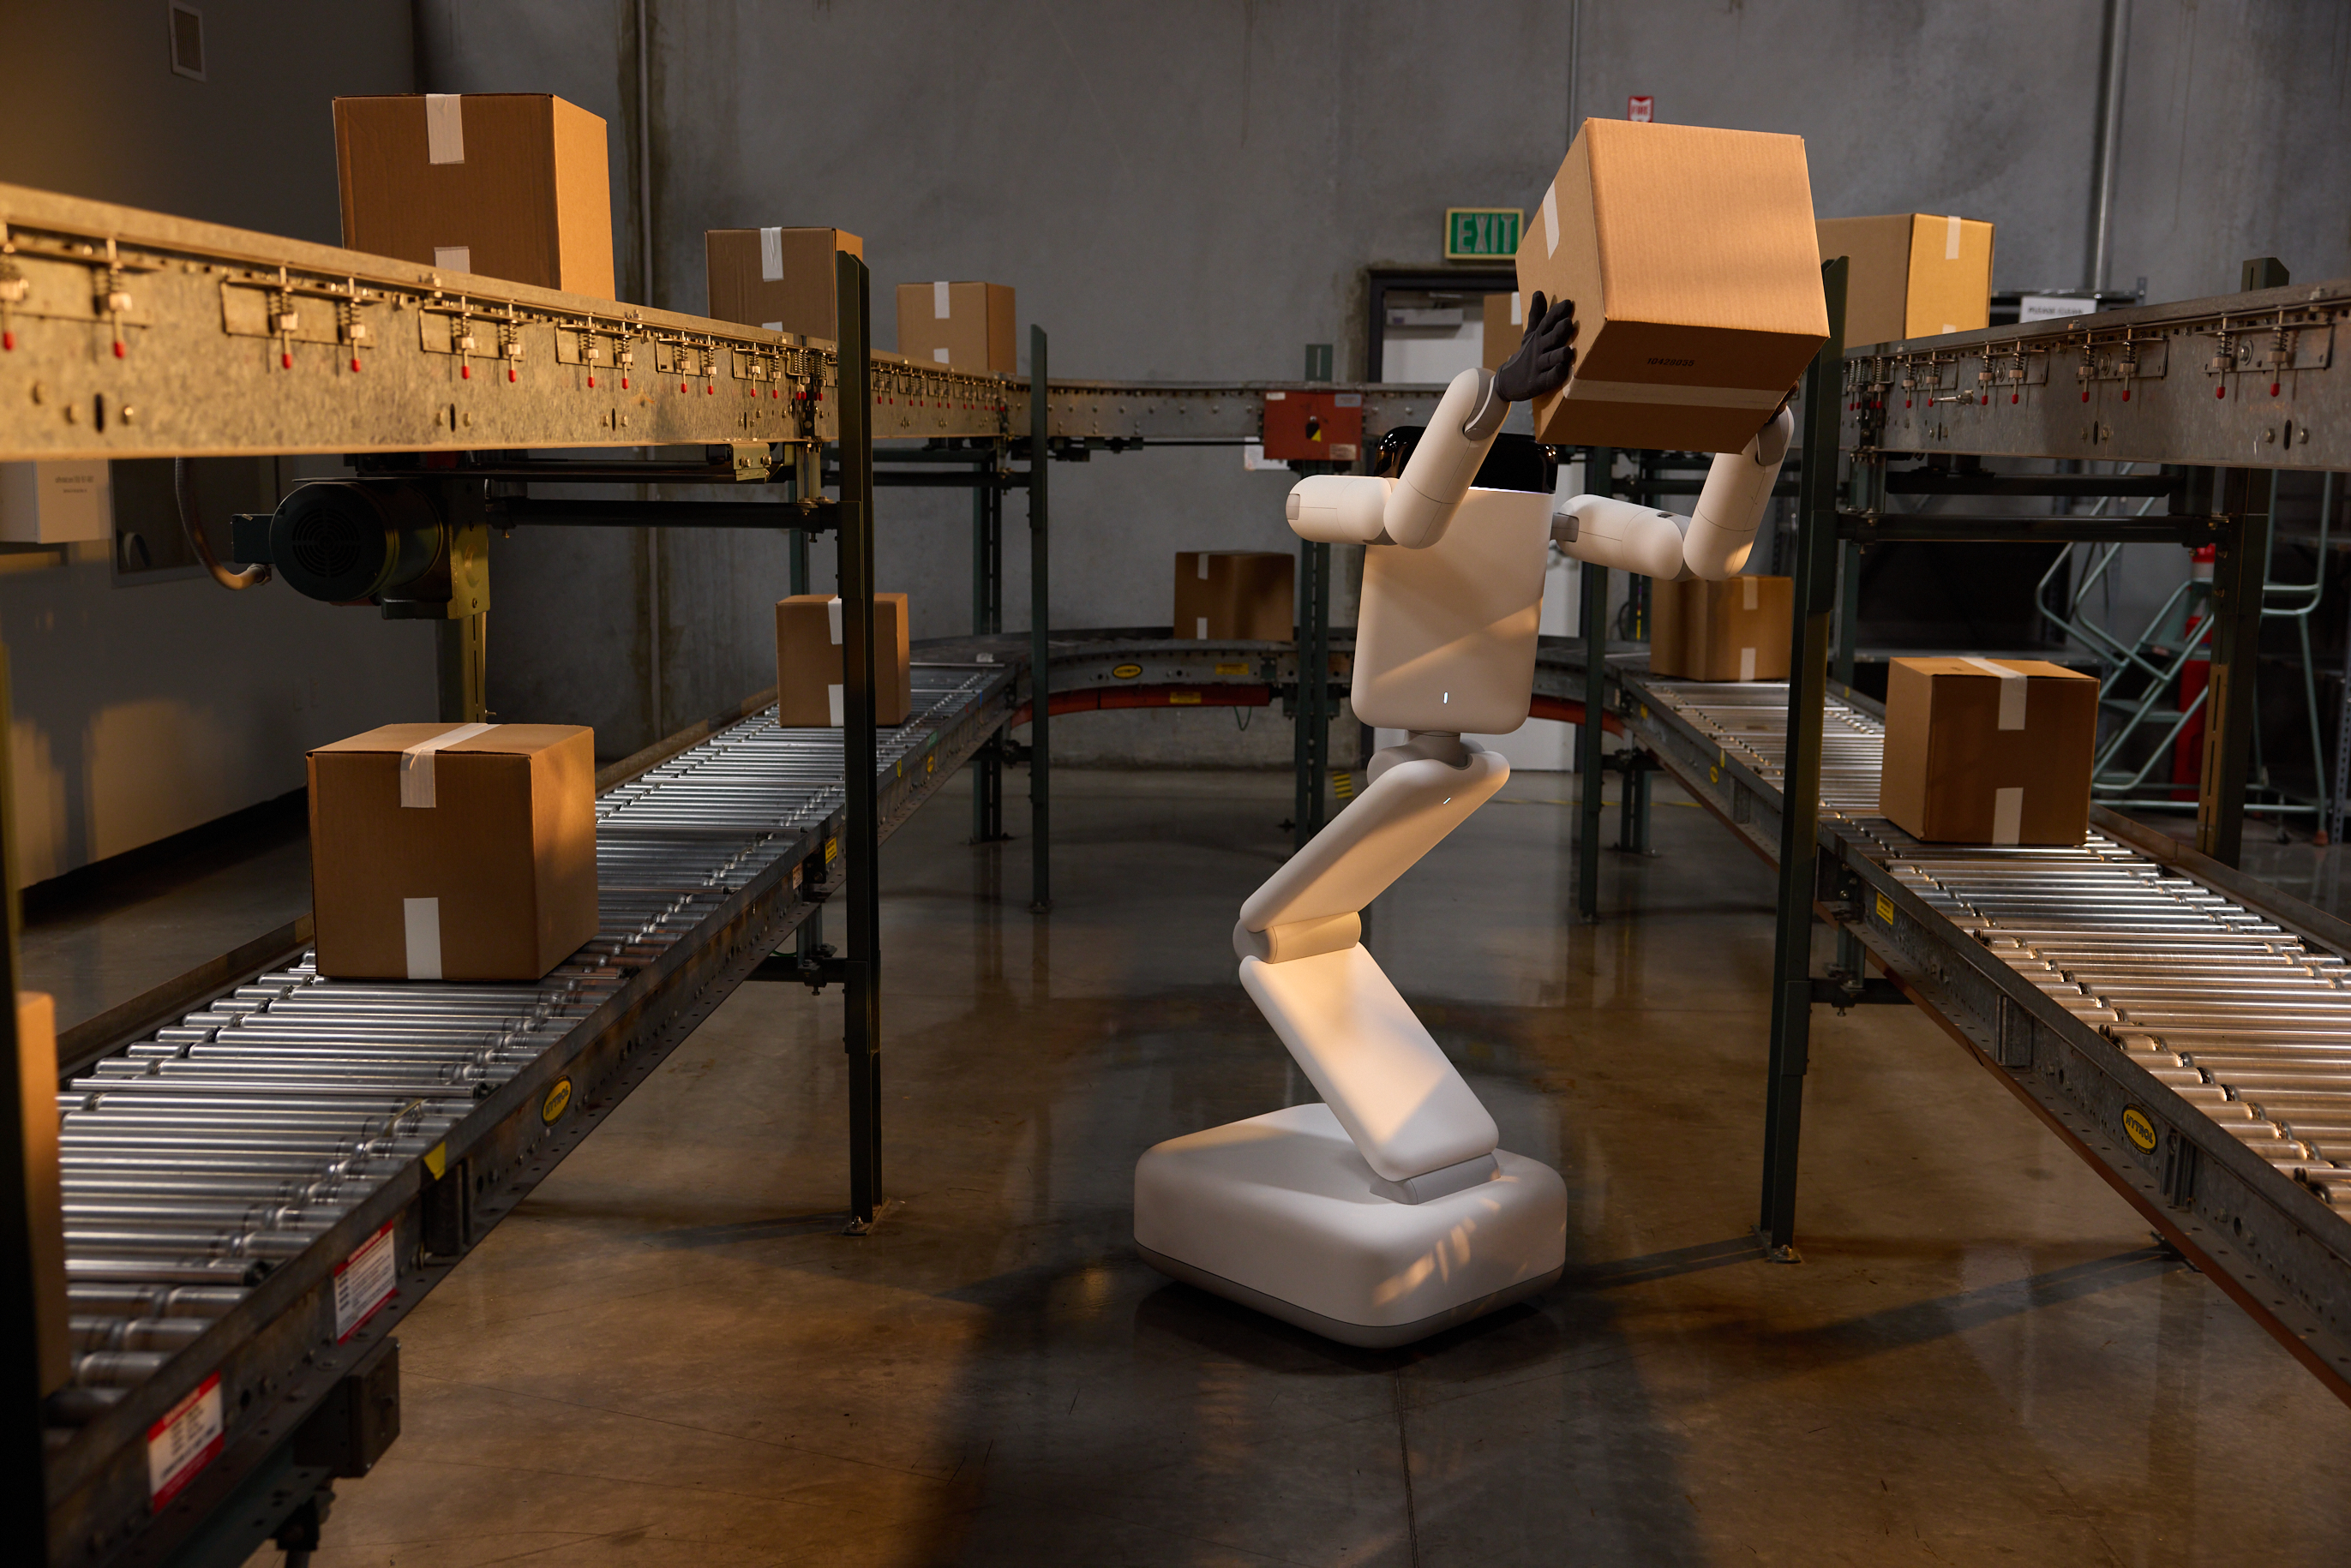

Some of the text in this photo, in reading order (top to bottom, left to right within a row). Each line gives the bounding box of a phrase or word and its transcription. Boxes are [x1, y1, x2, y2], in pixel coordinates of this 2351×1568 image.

[1456, 214, 1515, 253] EXIT
[545, 1085, 569, 1117] HYTROL
[2125, 1114, 2154, 1144] HYTROL
